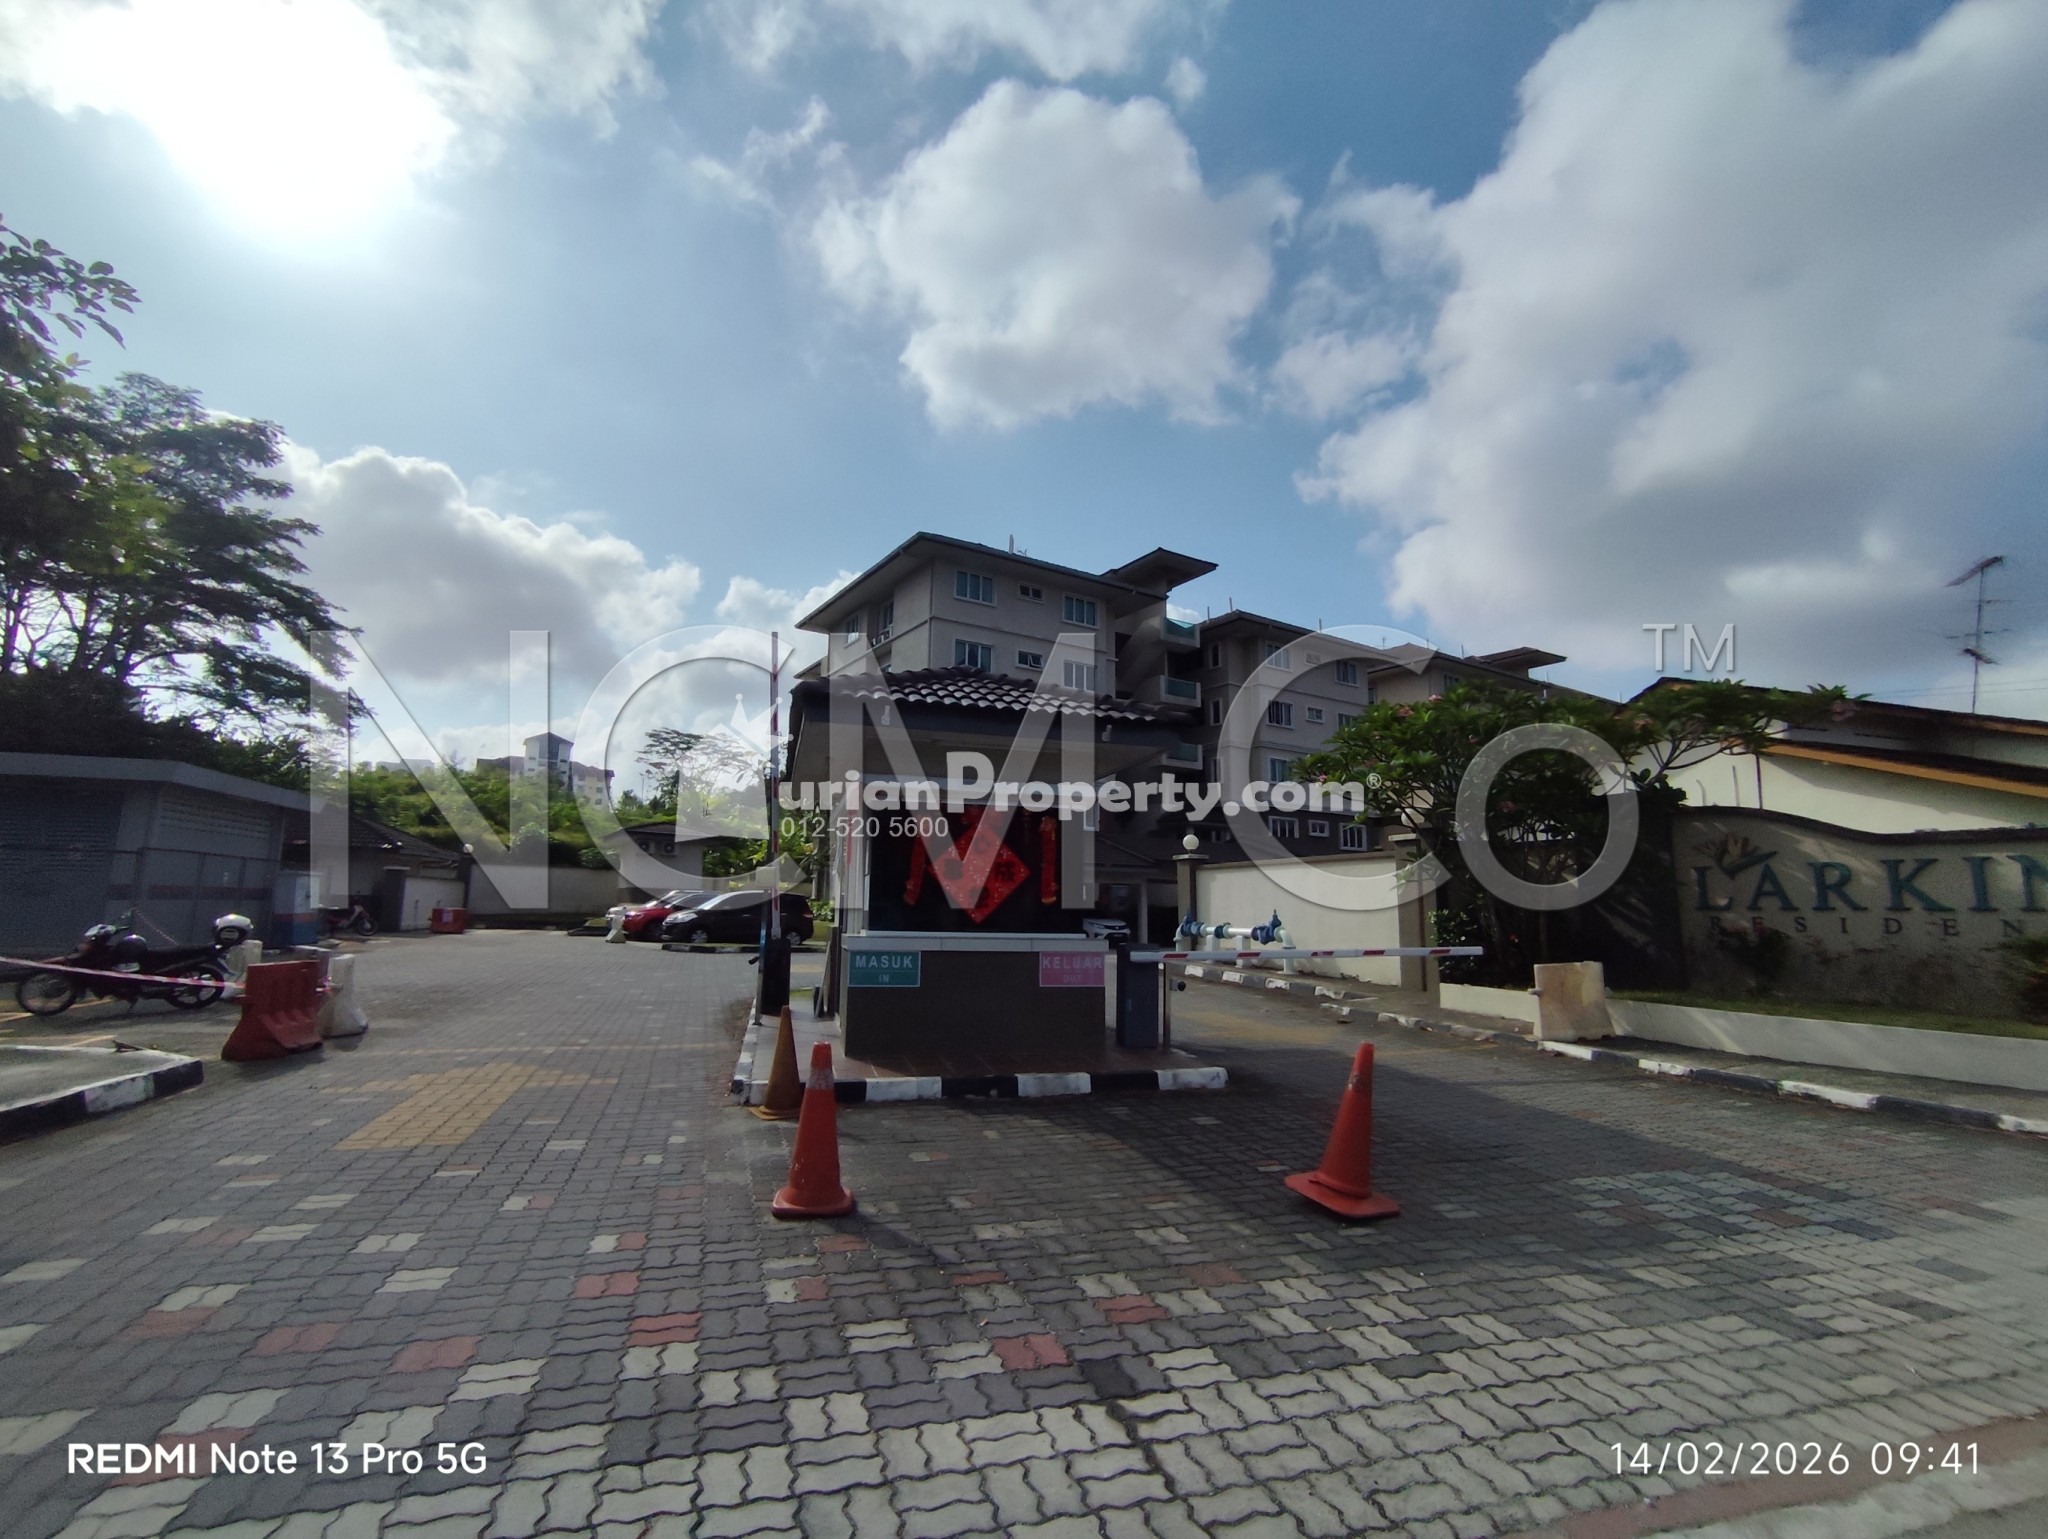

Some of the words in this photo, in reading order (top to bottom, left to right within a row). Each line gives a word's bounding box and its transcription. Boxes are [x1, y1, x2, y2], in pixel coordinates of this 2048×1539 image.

[855, 955, 913, 969] MASUK
[1042, 956, 1103, 969] KELUAR
[879, 974, 890, 983] IN
[1063, 974, 1082, 984] OUT
